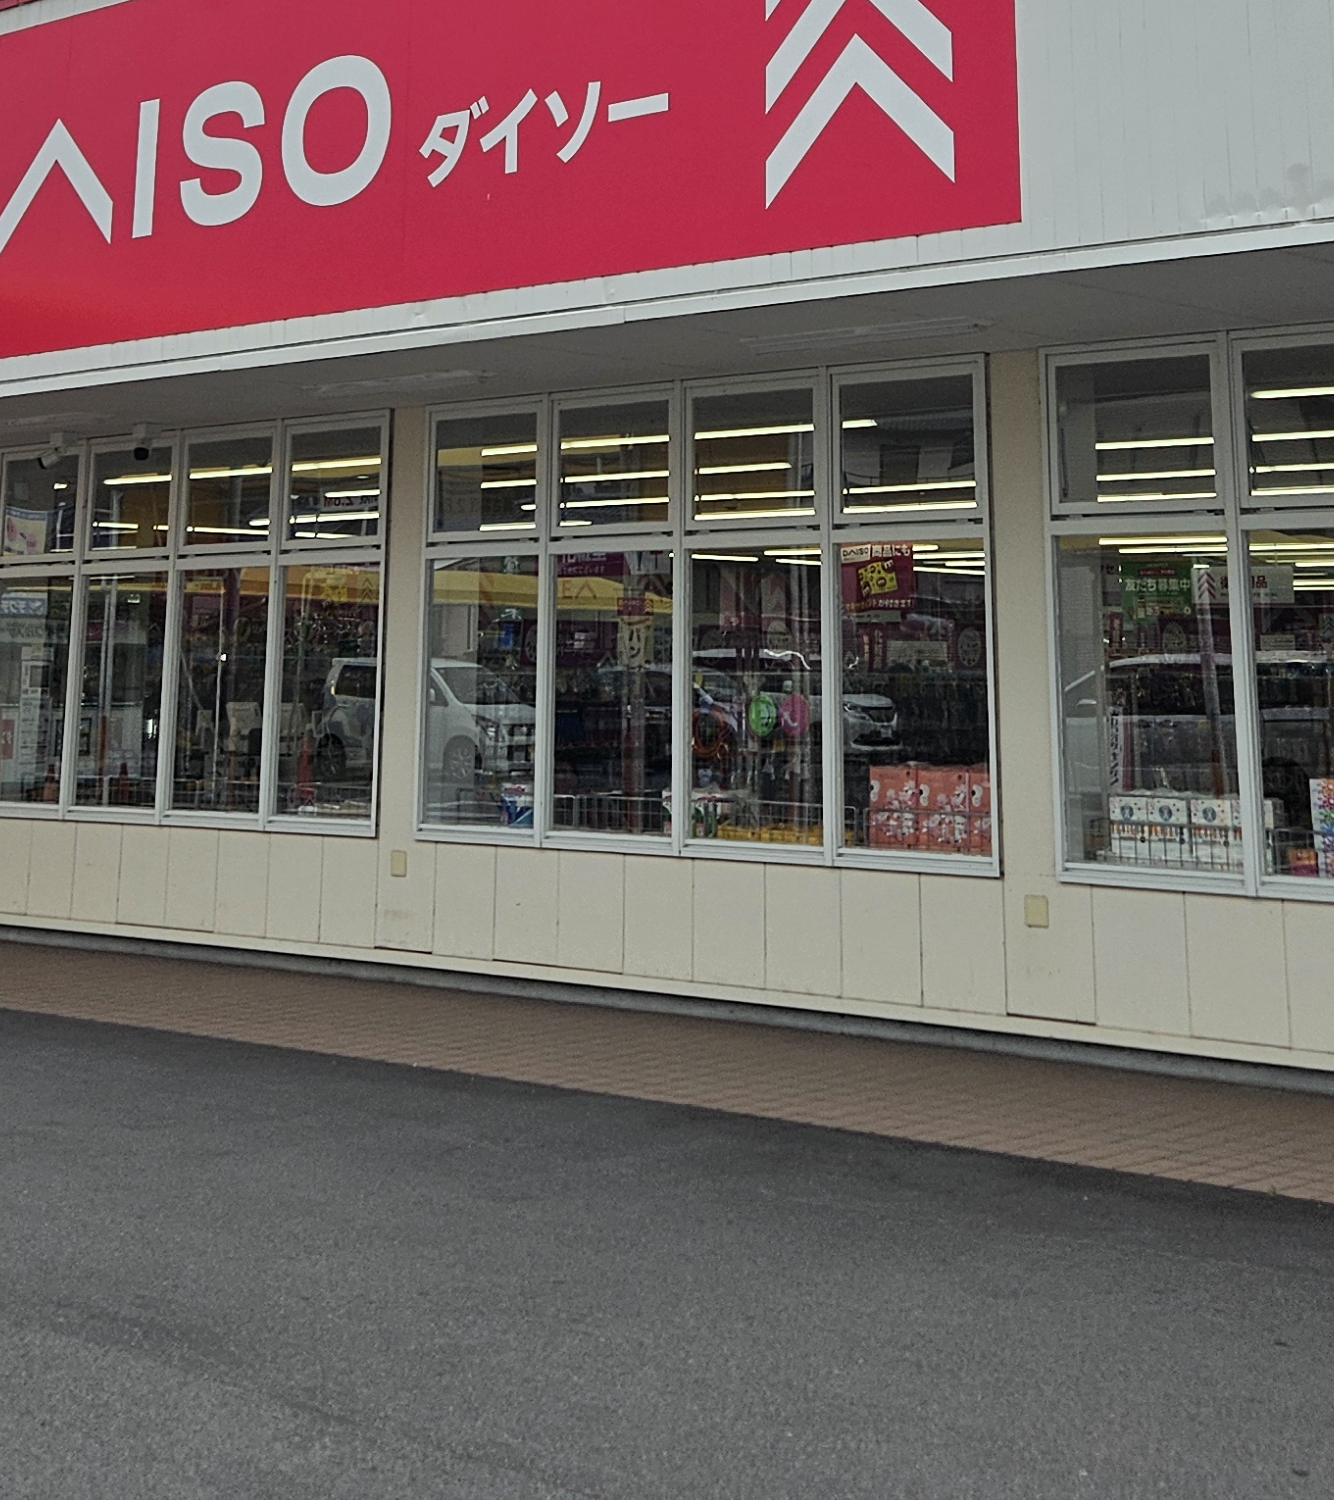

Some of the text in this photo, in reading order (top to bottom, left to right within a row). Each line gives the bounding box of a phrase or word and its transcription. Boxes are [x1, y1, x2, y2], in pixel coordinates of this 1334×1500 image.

[419, 81, 668, 188] ダイソー
[843, 546, 869, 557] DAISO
